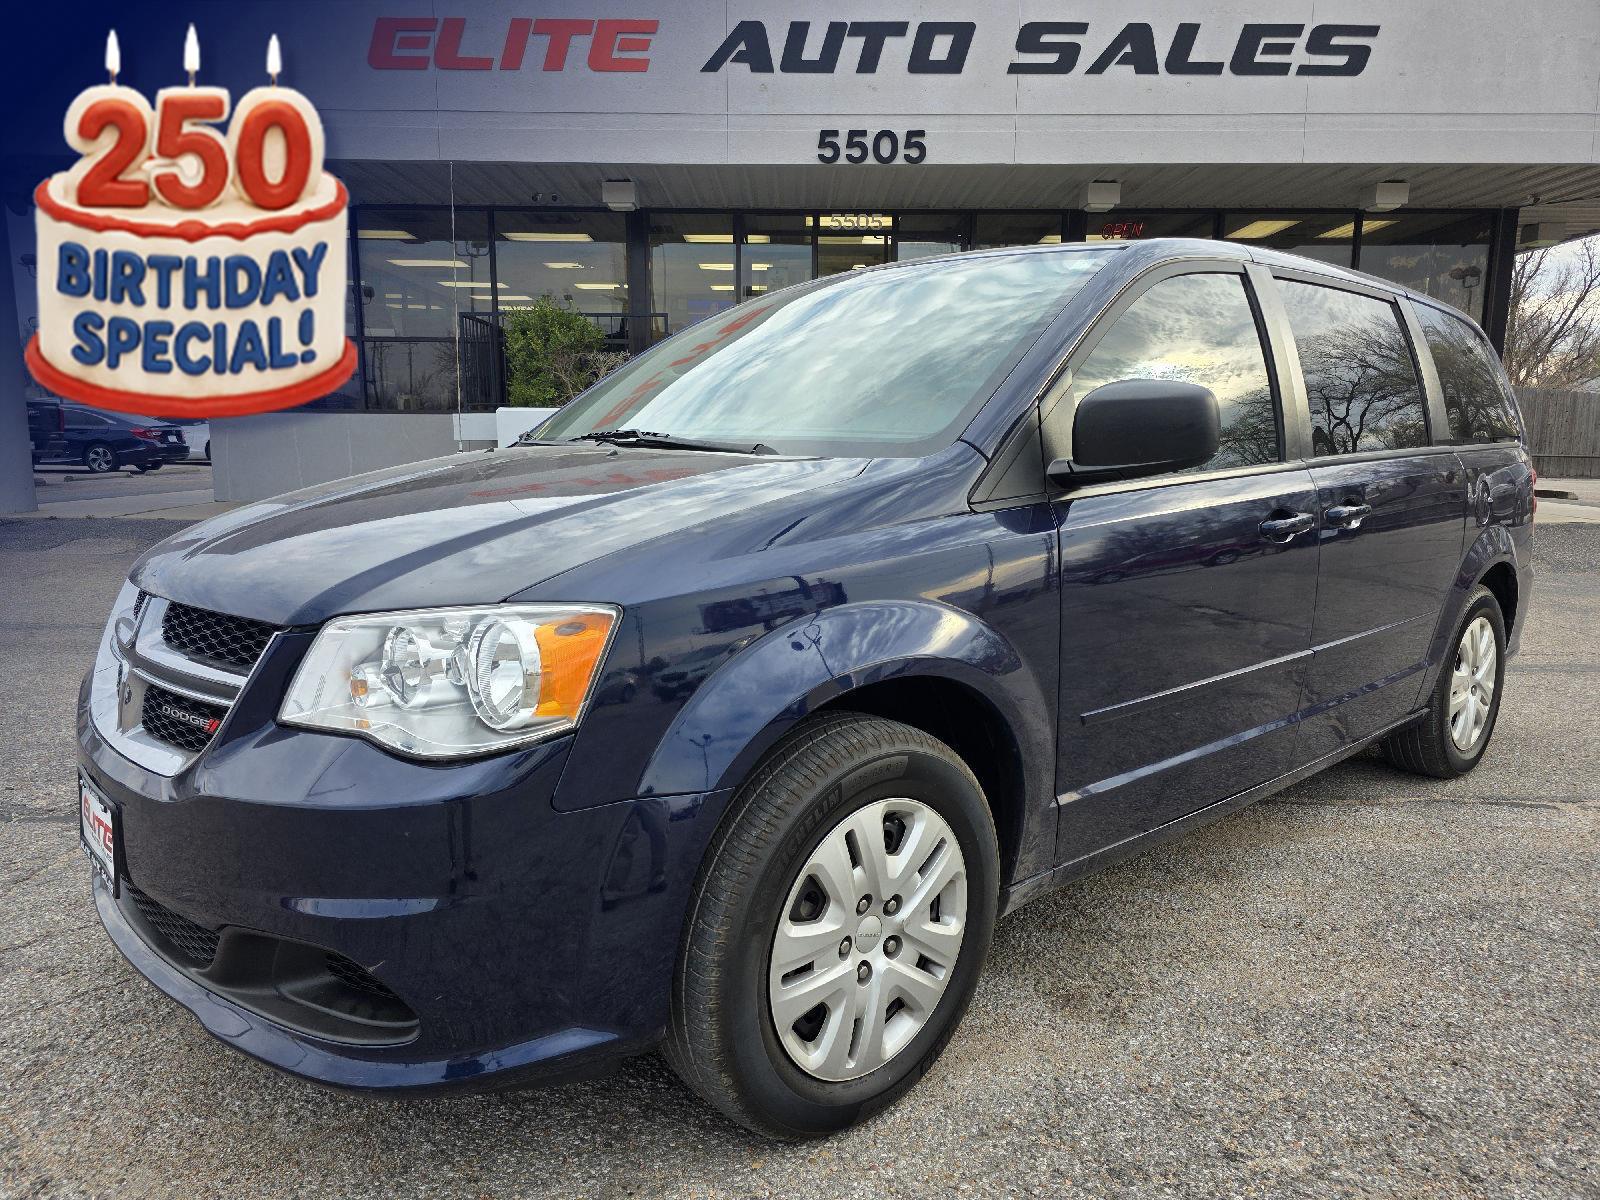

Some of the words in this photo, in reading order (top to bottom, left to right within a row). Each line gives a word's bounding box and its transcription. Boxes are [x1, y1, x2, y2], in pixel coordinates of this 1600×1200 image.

[368, 17, 660, 73] ELITE
[699, 20, 977, 75] AUTO
[1006, 21, 1381, 77] SALES
[817, 129, 927, 165] 5505
[829, 213, 882, 230] 5505
[1101, 222, 1145, 240] OPEN
[162, 705, 210, 730] DODGE
[83, 793, 113, 854] ELITE
